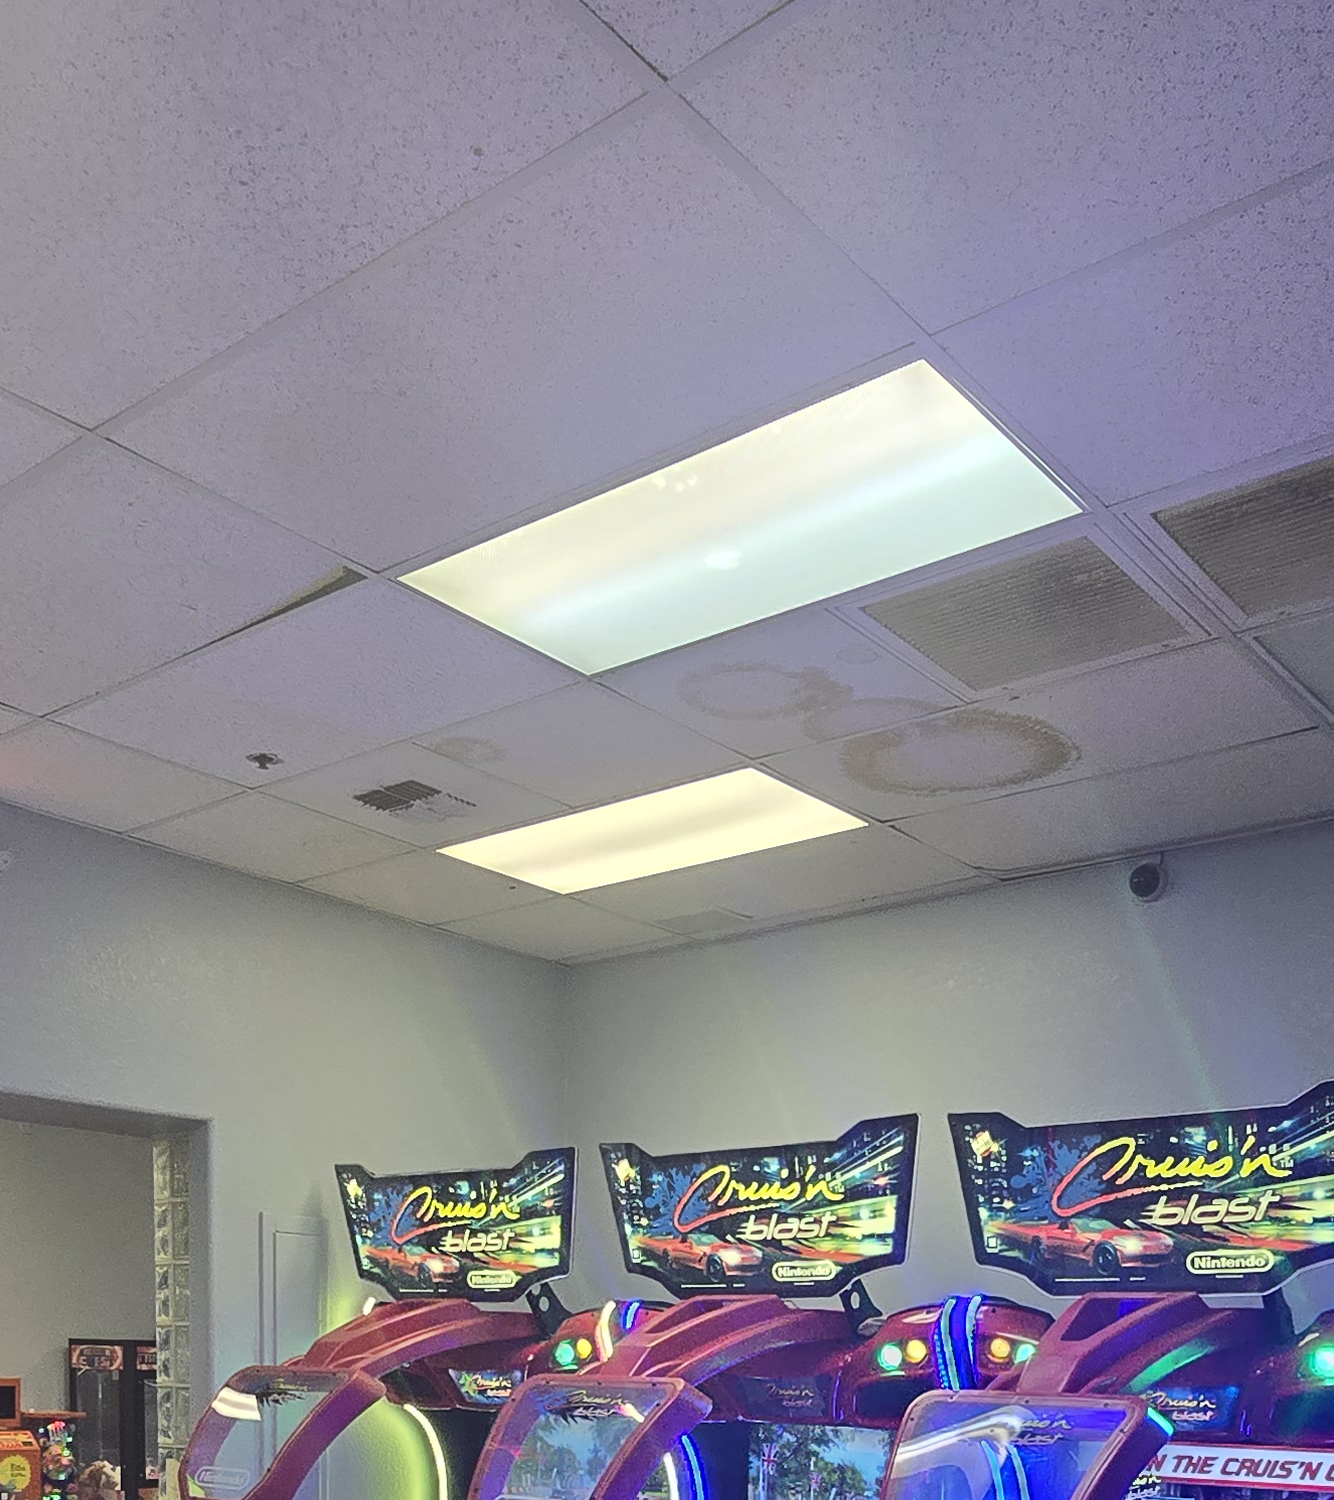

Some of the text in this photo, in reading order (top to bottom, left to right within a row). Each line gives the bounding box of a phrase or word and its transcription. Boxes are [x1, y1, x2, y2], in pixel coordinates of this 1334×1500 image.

[1051, 1135, 1293, 1218] Cruis'n
[673, 1164, 844, 1234] Cruis'n
[1140, 1190, 1282, 1227] blast
[389, 1185, 521, 1245] Cruis'n
[736, 1212, 837, 1241] blast
[439, 1229, 515, 1253] blast
[776, 1265, 832, 1278] Nintendo
[1192, 1256, 1266, 1270] Nintendo
[470, 1273, 514, 1286] Nintendo
[1172, 1455, 1219, 1475] THE
[1220, 1457, 1321, 1481] CRUIS'N
